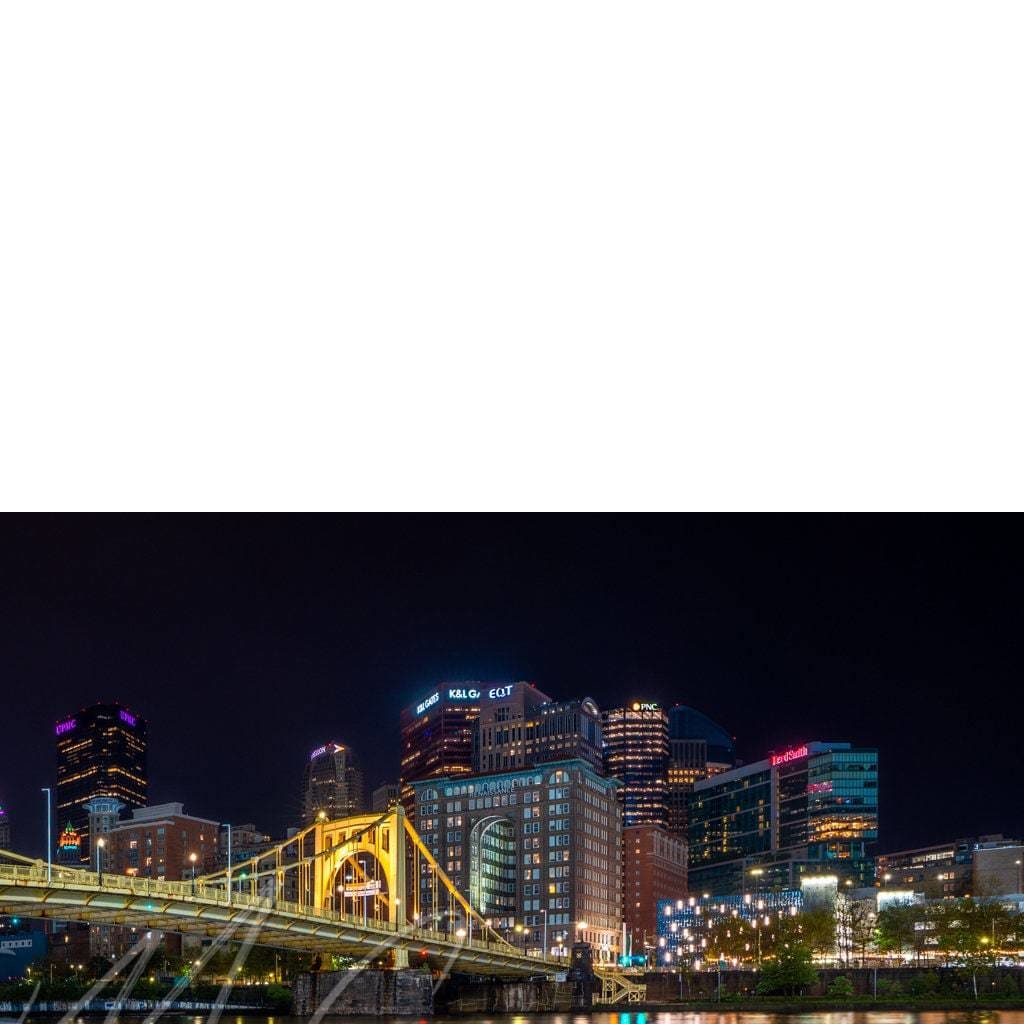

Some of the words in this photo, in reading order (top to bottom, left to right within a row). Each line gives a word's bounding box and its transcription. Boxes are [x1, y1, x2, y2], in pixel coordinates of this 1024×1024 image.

[449, 689, 467, 699] K&L
[489, 685, 513, 699] EQT
[640, 703, 658, 711] PNC
